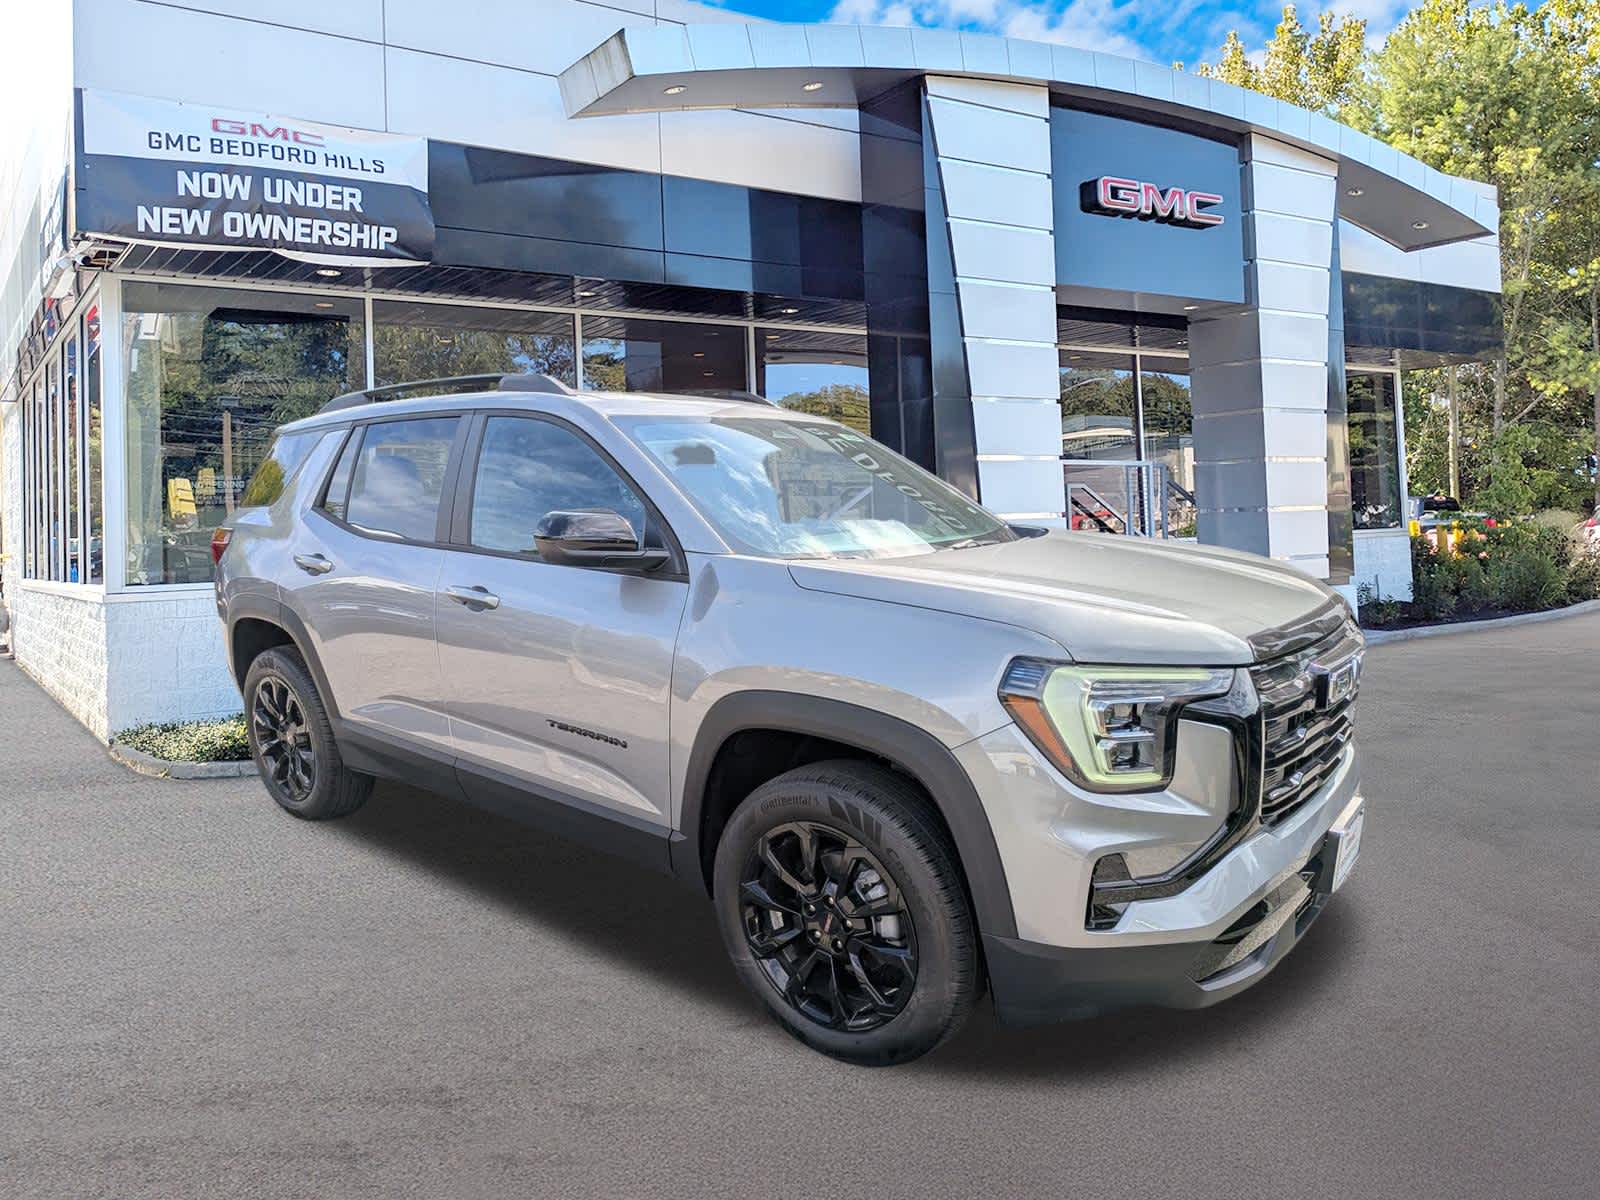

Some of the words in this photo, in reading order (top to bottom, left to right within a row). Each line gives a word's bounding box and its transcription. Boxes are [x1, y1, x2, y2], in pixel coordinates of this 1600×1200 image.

[148, 131, 201, 153] GMC
[210, 138, 316, 165] BEDFORD
[324, 153, 385, 174] HILLS
[211, 119, 326, 148] GMC
[176, 170, 252, 201] NOW
[263, 176, 363, 213] UNDER
[1098, 176, 1225, 225] GMC
[136, 206, 211, 236] NEW
[223, 211, 398, 250] OWNERSHIP
